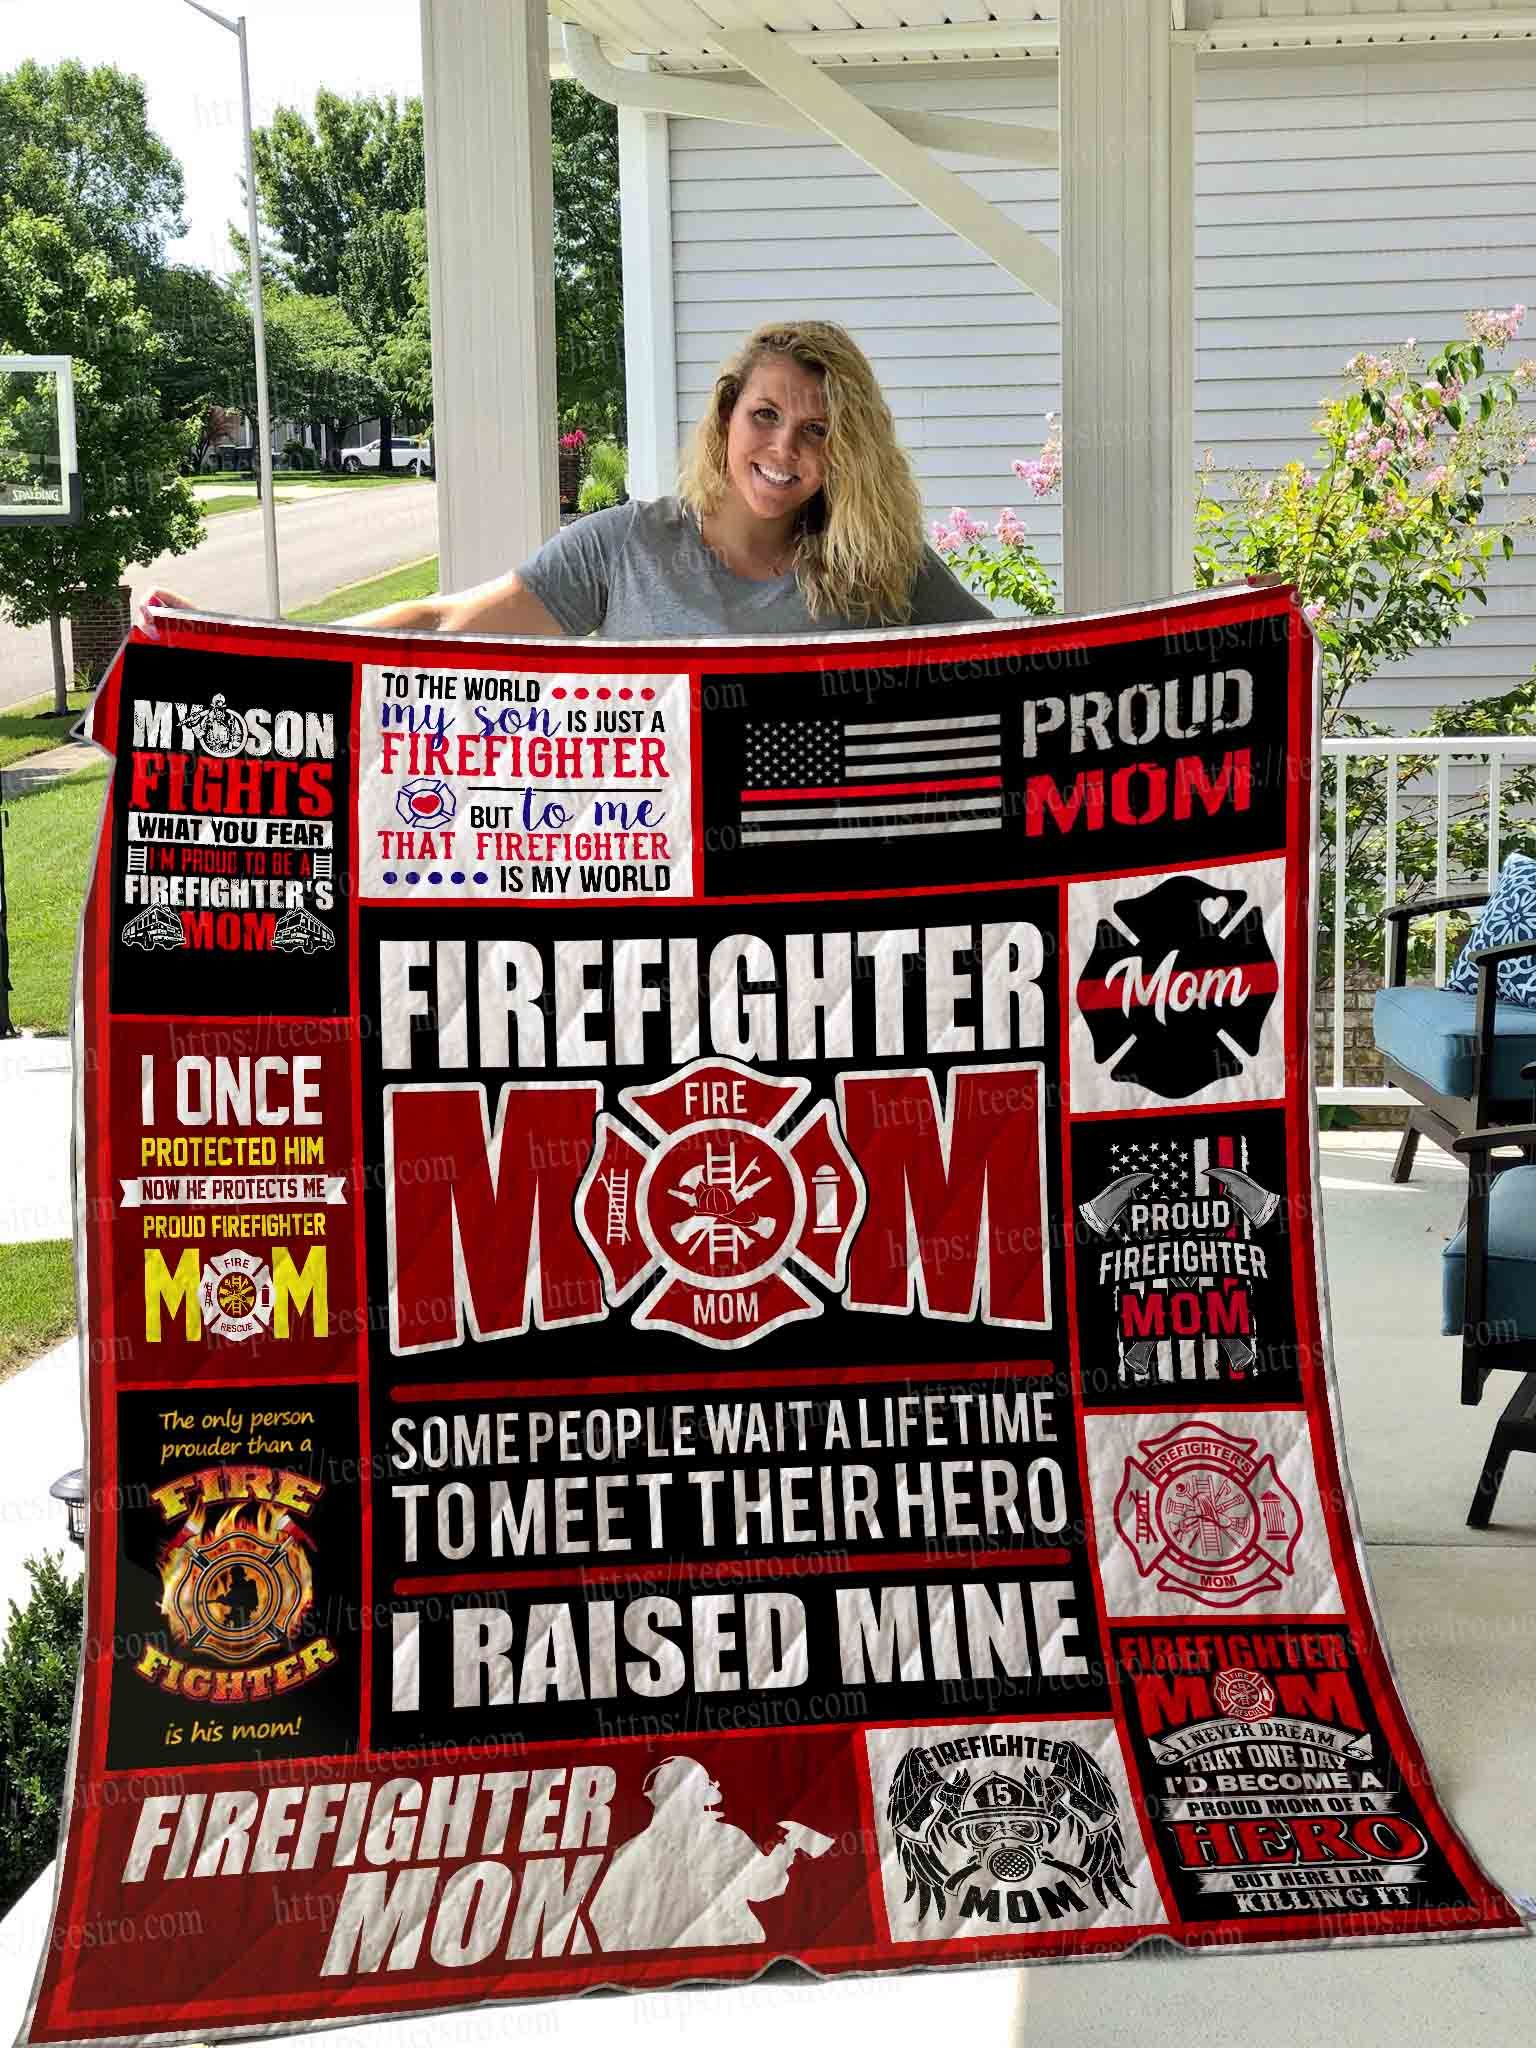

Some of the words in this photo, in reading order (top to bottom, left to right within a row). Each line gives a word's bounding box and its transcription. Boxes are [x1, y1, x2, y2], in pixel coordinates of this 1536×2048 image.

[382, 672, 408, 698] TO
[415, 674, 457, 700] THE
[464, 677, 540, 702] WORLD
[132, 699, 203, 751] MY
[245, 707, 334, 758] SON
[382, 702, 455, 749] my
[474, 705, 561, 736] son
[567, 711, 586, 732] IS
[594, 711, 644, 733] JUST
[651, 711, 665, 732] A
[1022, 668, 1254, 758] PROUD
[381, 732, 669, 778] FIREFIGHTER
[129, 751, 333, 817] FIGHTS
[1024, 747, 1253, 838] MOM
[471, 806, 513, 828] BUT
[520, 787, 574, 831] to
[595, 800, 665, 829] me
[138, 815, 202, 841] WHAT
[211, 820, 257, 843] YOU
[266, 823, 323, 845] FEAR
[377, 831, 456, 859] THAT
[476, 832, 670, 861] FIREFIGHTER
[149, 847, 174, 865] I'M
[181, 849, 237, 873] PROUD
[245, 851, 265, 874] TO
[272, 852, 293, 875] BE
[300, 854, 311, 875] A
[125, 875, 333, 910] FIREFIGHTER'S
[500, 865, 523, 891] IS
[531, 865, 571, 892] MY
[580, 865, 670, 892] WORLD
[182, 911, 276, 950] MOM
[379, 921, 1045, 1070] FIREFIGHTER
[1104, 950, 1251, 1026] Mom
[141, 1054, 155, 1126] I
[176, 1055, 323, 1126] ONCE
[685, 1080, 747, 1115] FIRE
[141, 1137, 276, 1168] PROTECTED
[284, 1136, 325, 1165] HIM
[141, 1179, 180, 1200] NOW
[186, 1178, 207, 1200] HE
[212, 1177, 298, 1200] PROTECTS
[303, 1177, 326, 1198] ME
[143, 1214, 206, 1239] PROUD
[211, 1212, 327, 1238] FIREFIGHTER
[1131, 1200, 1230, 1232] PROUD
[224, 1257, 250, 1269] FIRE
[1099, 1240, 1268, 1286] FIREFIGHTER
[693, 1292, 759, 1325] MOM
[1121, 1290, 1250, 1337] MOM
[220, 1322, 254, 1333] RESCUE
[159, 1409, 194, 1430] The
[202, 1408, 243, 1433] only
[250, 1409, 315, 1433] person
[391, 1412, 520, 1470] SOME
[530, 1404, 697, 1464] PEOPLE
[704, 1400, 824, 1455] WAIT
[825, 1399, 852, 1450] A
[861, 1392, 1058, 1449] LIFETIME
[160, 1437, 242, 1464] prouder
[247, 1435, 293, 1455] than
[301, 1438, 312, 1453] a
[1150, 1443, 1251, 1476] FIREFIGHTER'S
[151, 1466, 322, 1521] FIRE
[392, 1479, 476, 1563] TO
[490, 1473, 672, 1558] MEET
[688, 1464, 885, 1547] THEIR
[897, 1457, 1069, 1538] HERO
[1200, 1575, 1237, 1588] MOM
[391, 1612, 421, 1712] I
[452, 1590, 808, 1709] RAISED
[836, 1580, 1089, 1686] MINE
[1119, 1633, 1350, 1671] FIREFIGHTER
[138, 1638, 335, 1701] FIGHTER
[1230, 1672, 1249, 1680] FIRE
[1234, 1707, 1262, 1718] RESCUE
[165, 1722, 183, 1745] is
[191, 1720, 224, 1743] his
[232, 1716, 302, 1738] mom!
[1178, 1735, 1191, 1750] I
[1193, 1722, 1254, 1745] NEVER
[1256, 1722, 1336, 1748] DREAM
[917, 1734, 1070, 1771] FIREFIGHTER
[1184, 1747, 1242, 1773] THAT
[1247, 1744, 1299, 1768] ONE
[1302, 1747, 1347, 1770] DAY
[985, 1783, 1012, 1805] 15
[1165, 1776, 1208, 1794] I'D
[1216, 1771, 1352, 1792] BECOME
[1361, 1772, 1384, 1788] A
[1188, 1799, 1262, 1818] PROUD
[1268, 1798, 1323, 1815] MOM
[1328, 1797, 1354, 1812] OF
[1360, 1796, 1376, 1811] A
[121, 1765, 617, 1884] FIREFIGHTER
[1168, 1816, 1428, 1870] HERO
[1231, 1872, 1273, 1889] BUT
[1278, 1870, 1335, 1887] HERE
[1337, 1870, 1346, 1884] I
[1350, 1867, 1384, 1884] AM
[959, 1880, 1089, 1924] MOM
[1233, 1887, 1369, 1913] KILLING
[1374, 1886, 1411, 1905] IT
